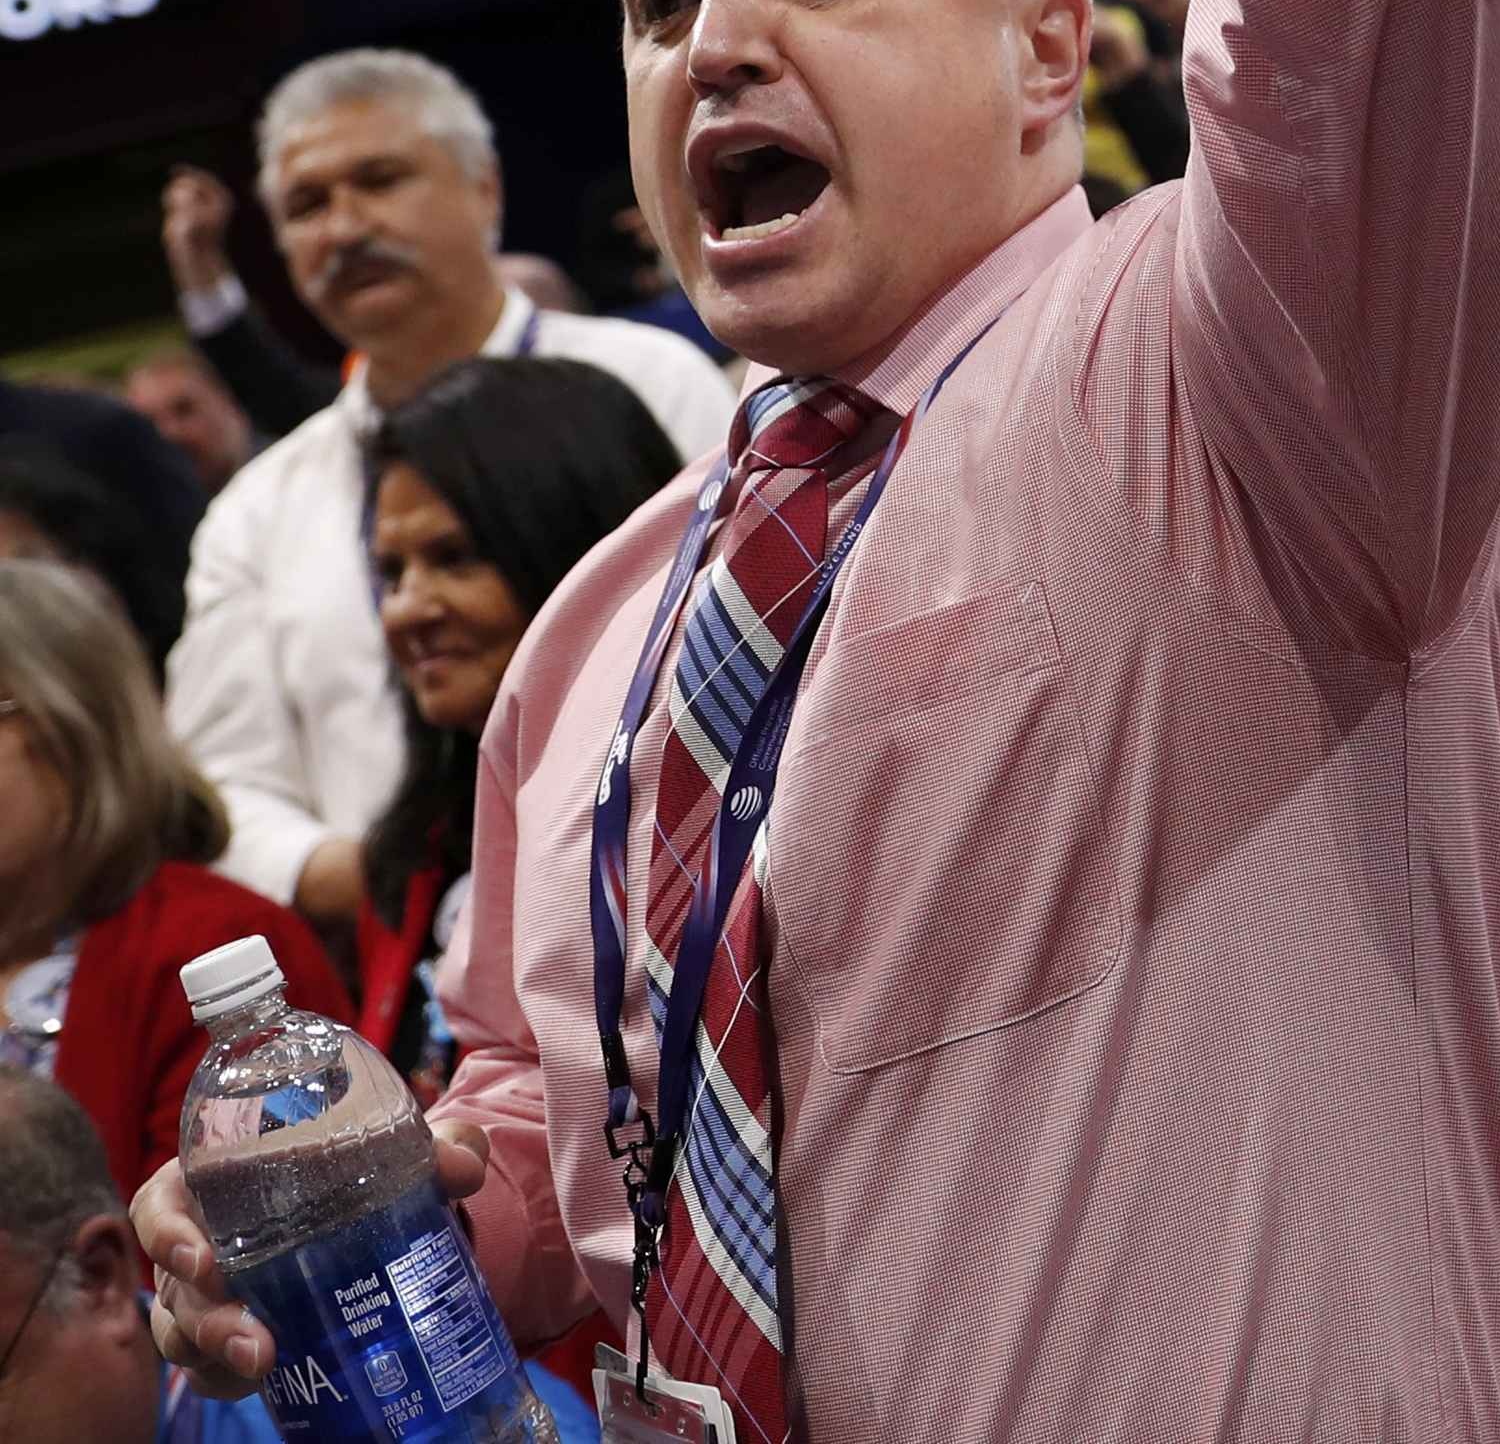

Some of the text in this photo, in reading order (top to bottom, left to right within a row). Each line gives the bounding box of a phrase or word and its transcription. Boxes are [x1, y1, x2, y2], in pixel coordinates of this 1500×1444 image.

[335, 1273, 380, 1305] Purified
[341, 1290, 391, 1322] Drinking
[348, 1314, 383, 1338] Water
